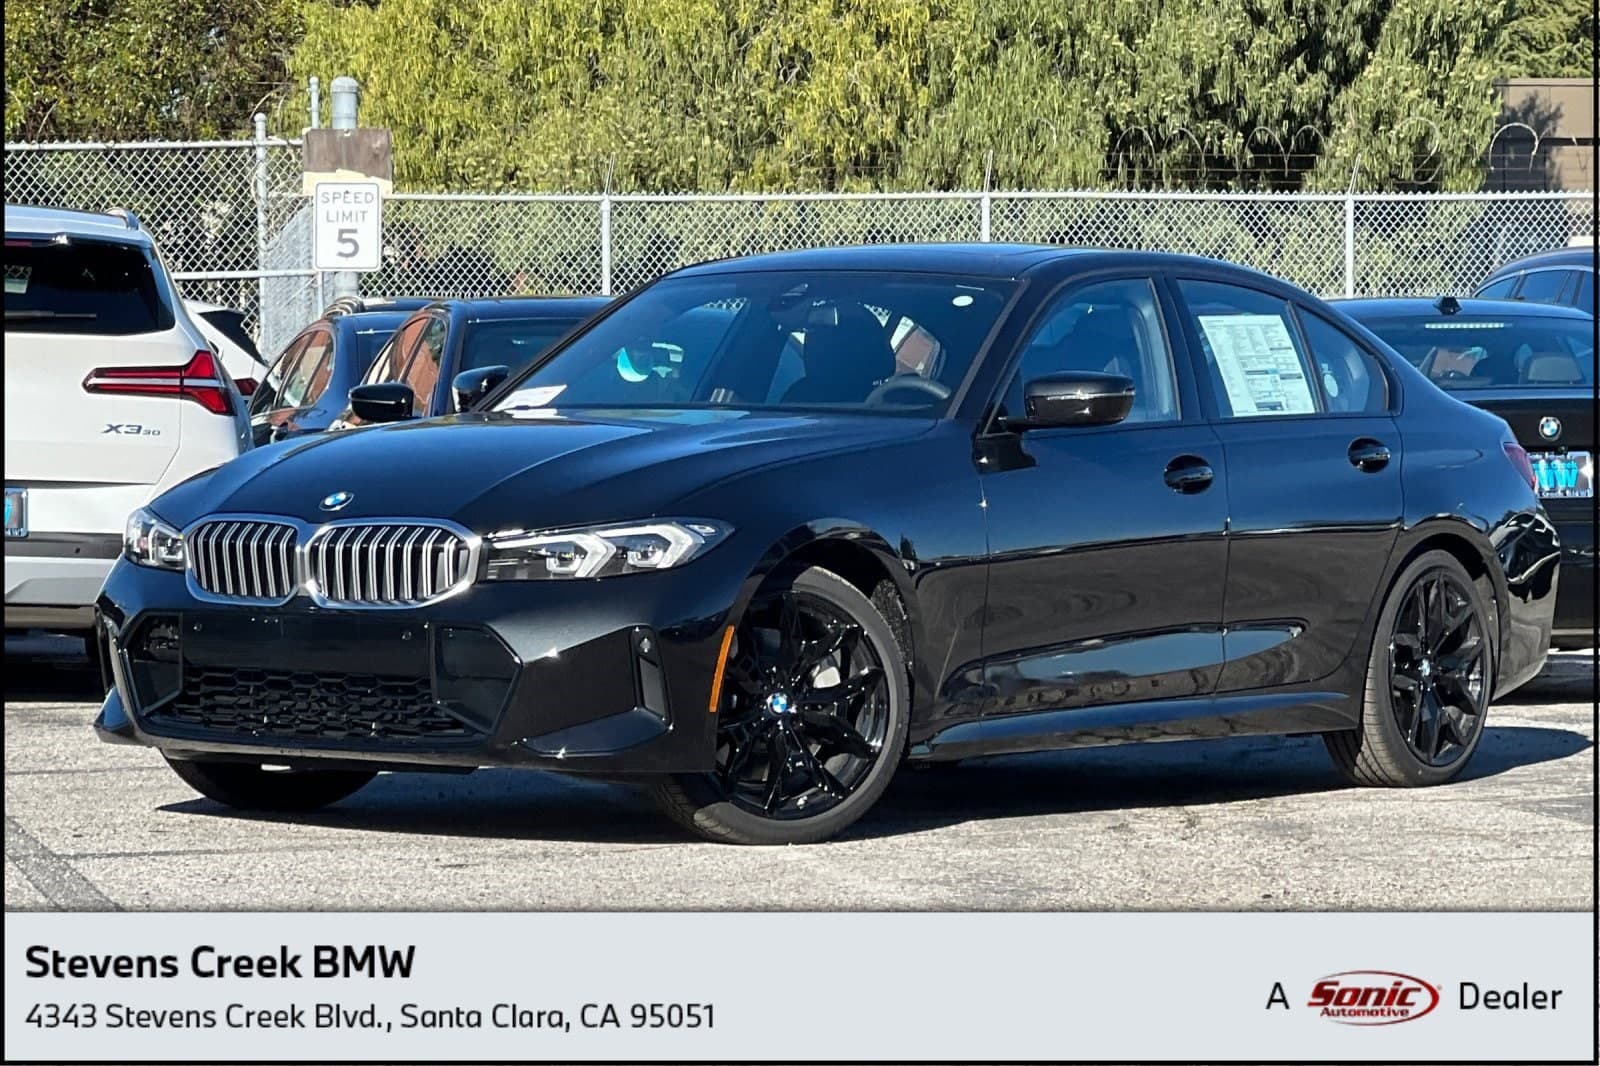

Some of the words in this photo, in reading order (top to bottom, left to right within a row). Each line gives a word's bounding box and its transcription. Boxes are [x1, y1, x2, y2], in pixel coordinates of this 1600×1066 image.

[321, 191, 374, 204] SPEED
[326, 210, 368, 223] LIMIT
[336, 228, 360, 258] 5
